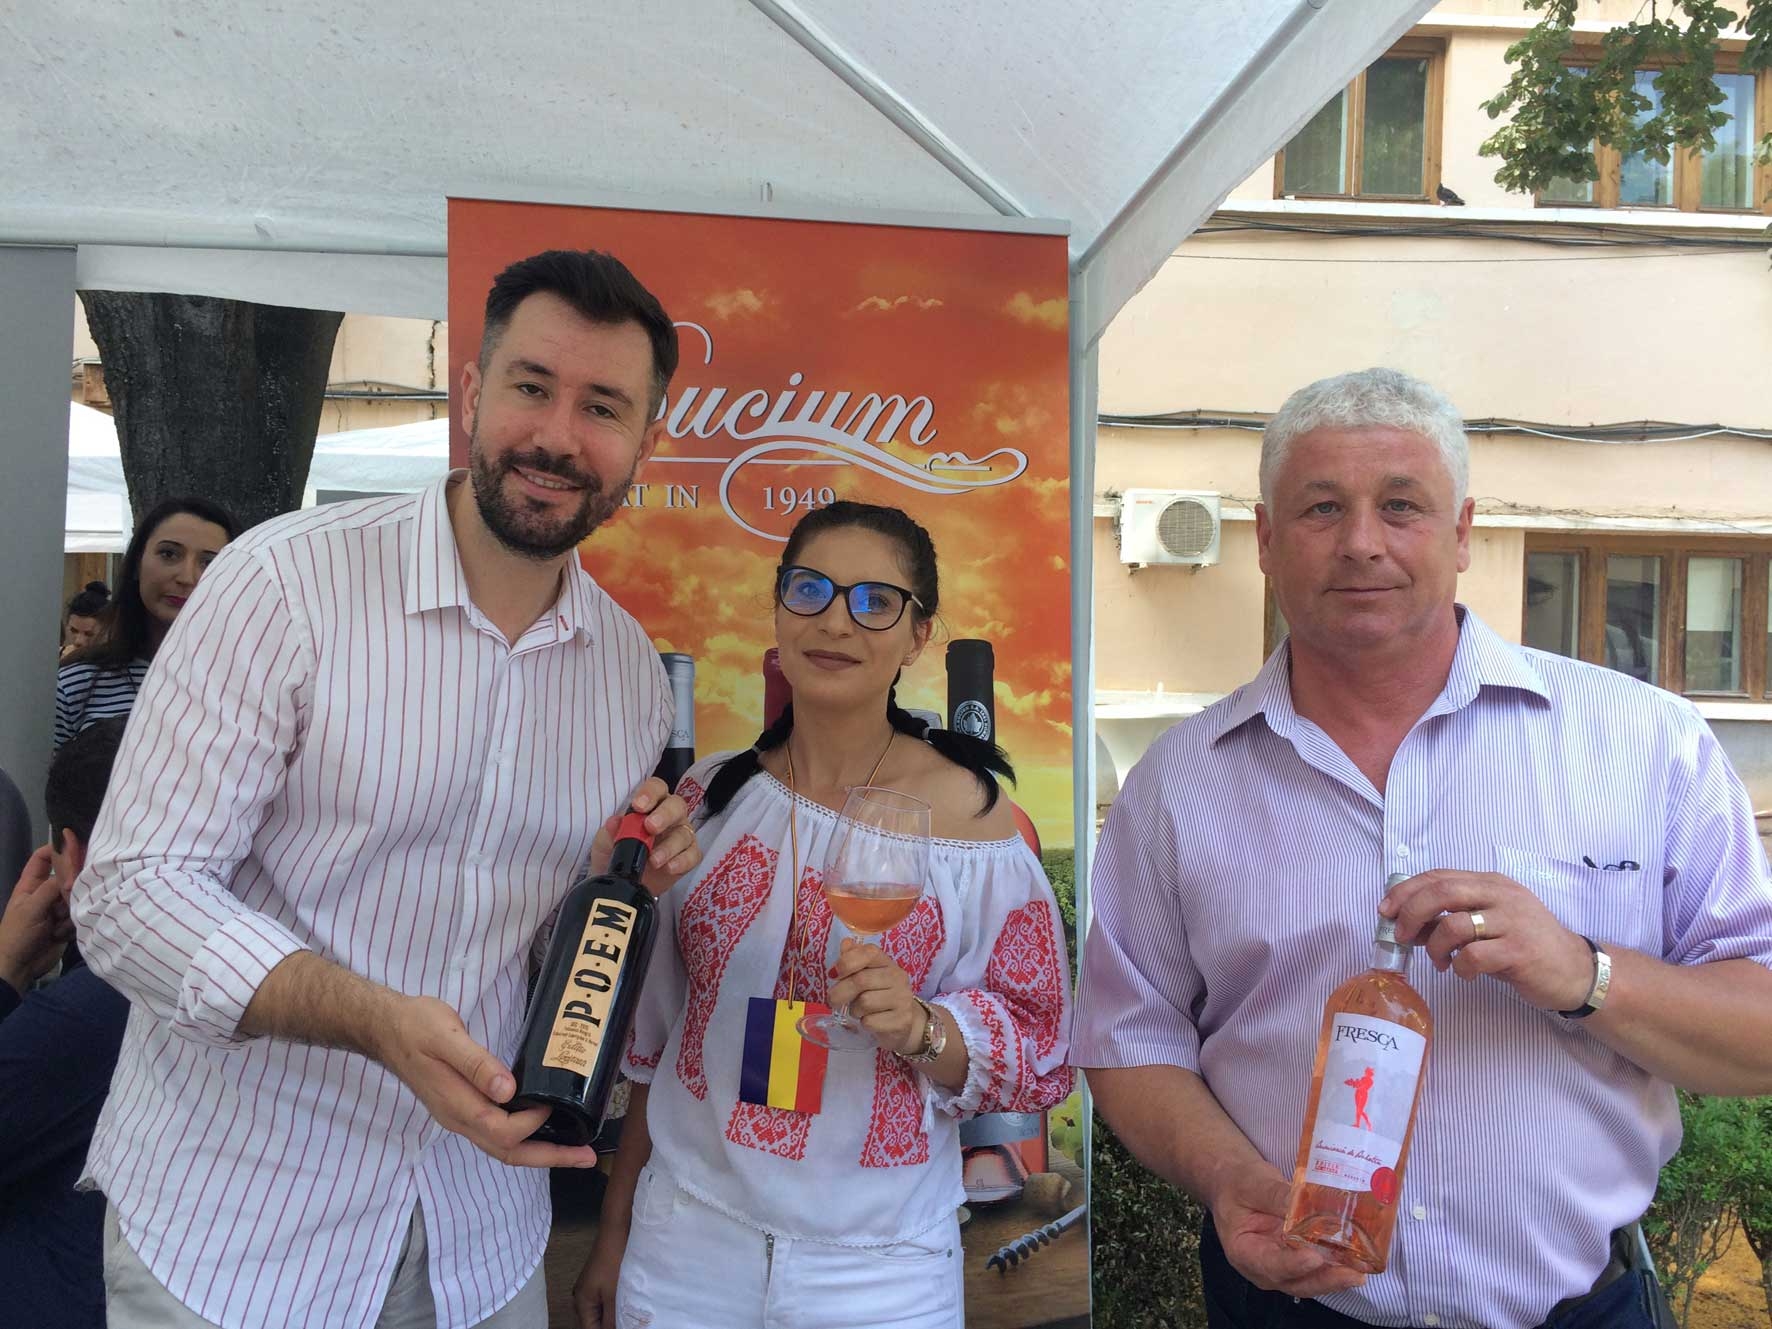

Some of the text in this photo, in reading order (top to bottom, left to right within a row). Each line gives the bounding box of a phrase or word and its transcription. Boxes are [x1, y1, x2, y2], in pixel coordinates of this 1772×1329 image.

[657, 340, 938, 447] ucium
[664, 485, 700, 508] IN
[1336, 1025, 1399, 1050] FRESCA
